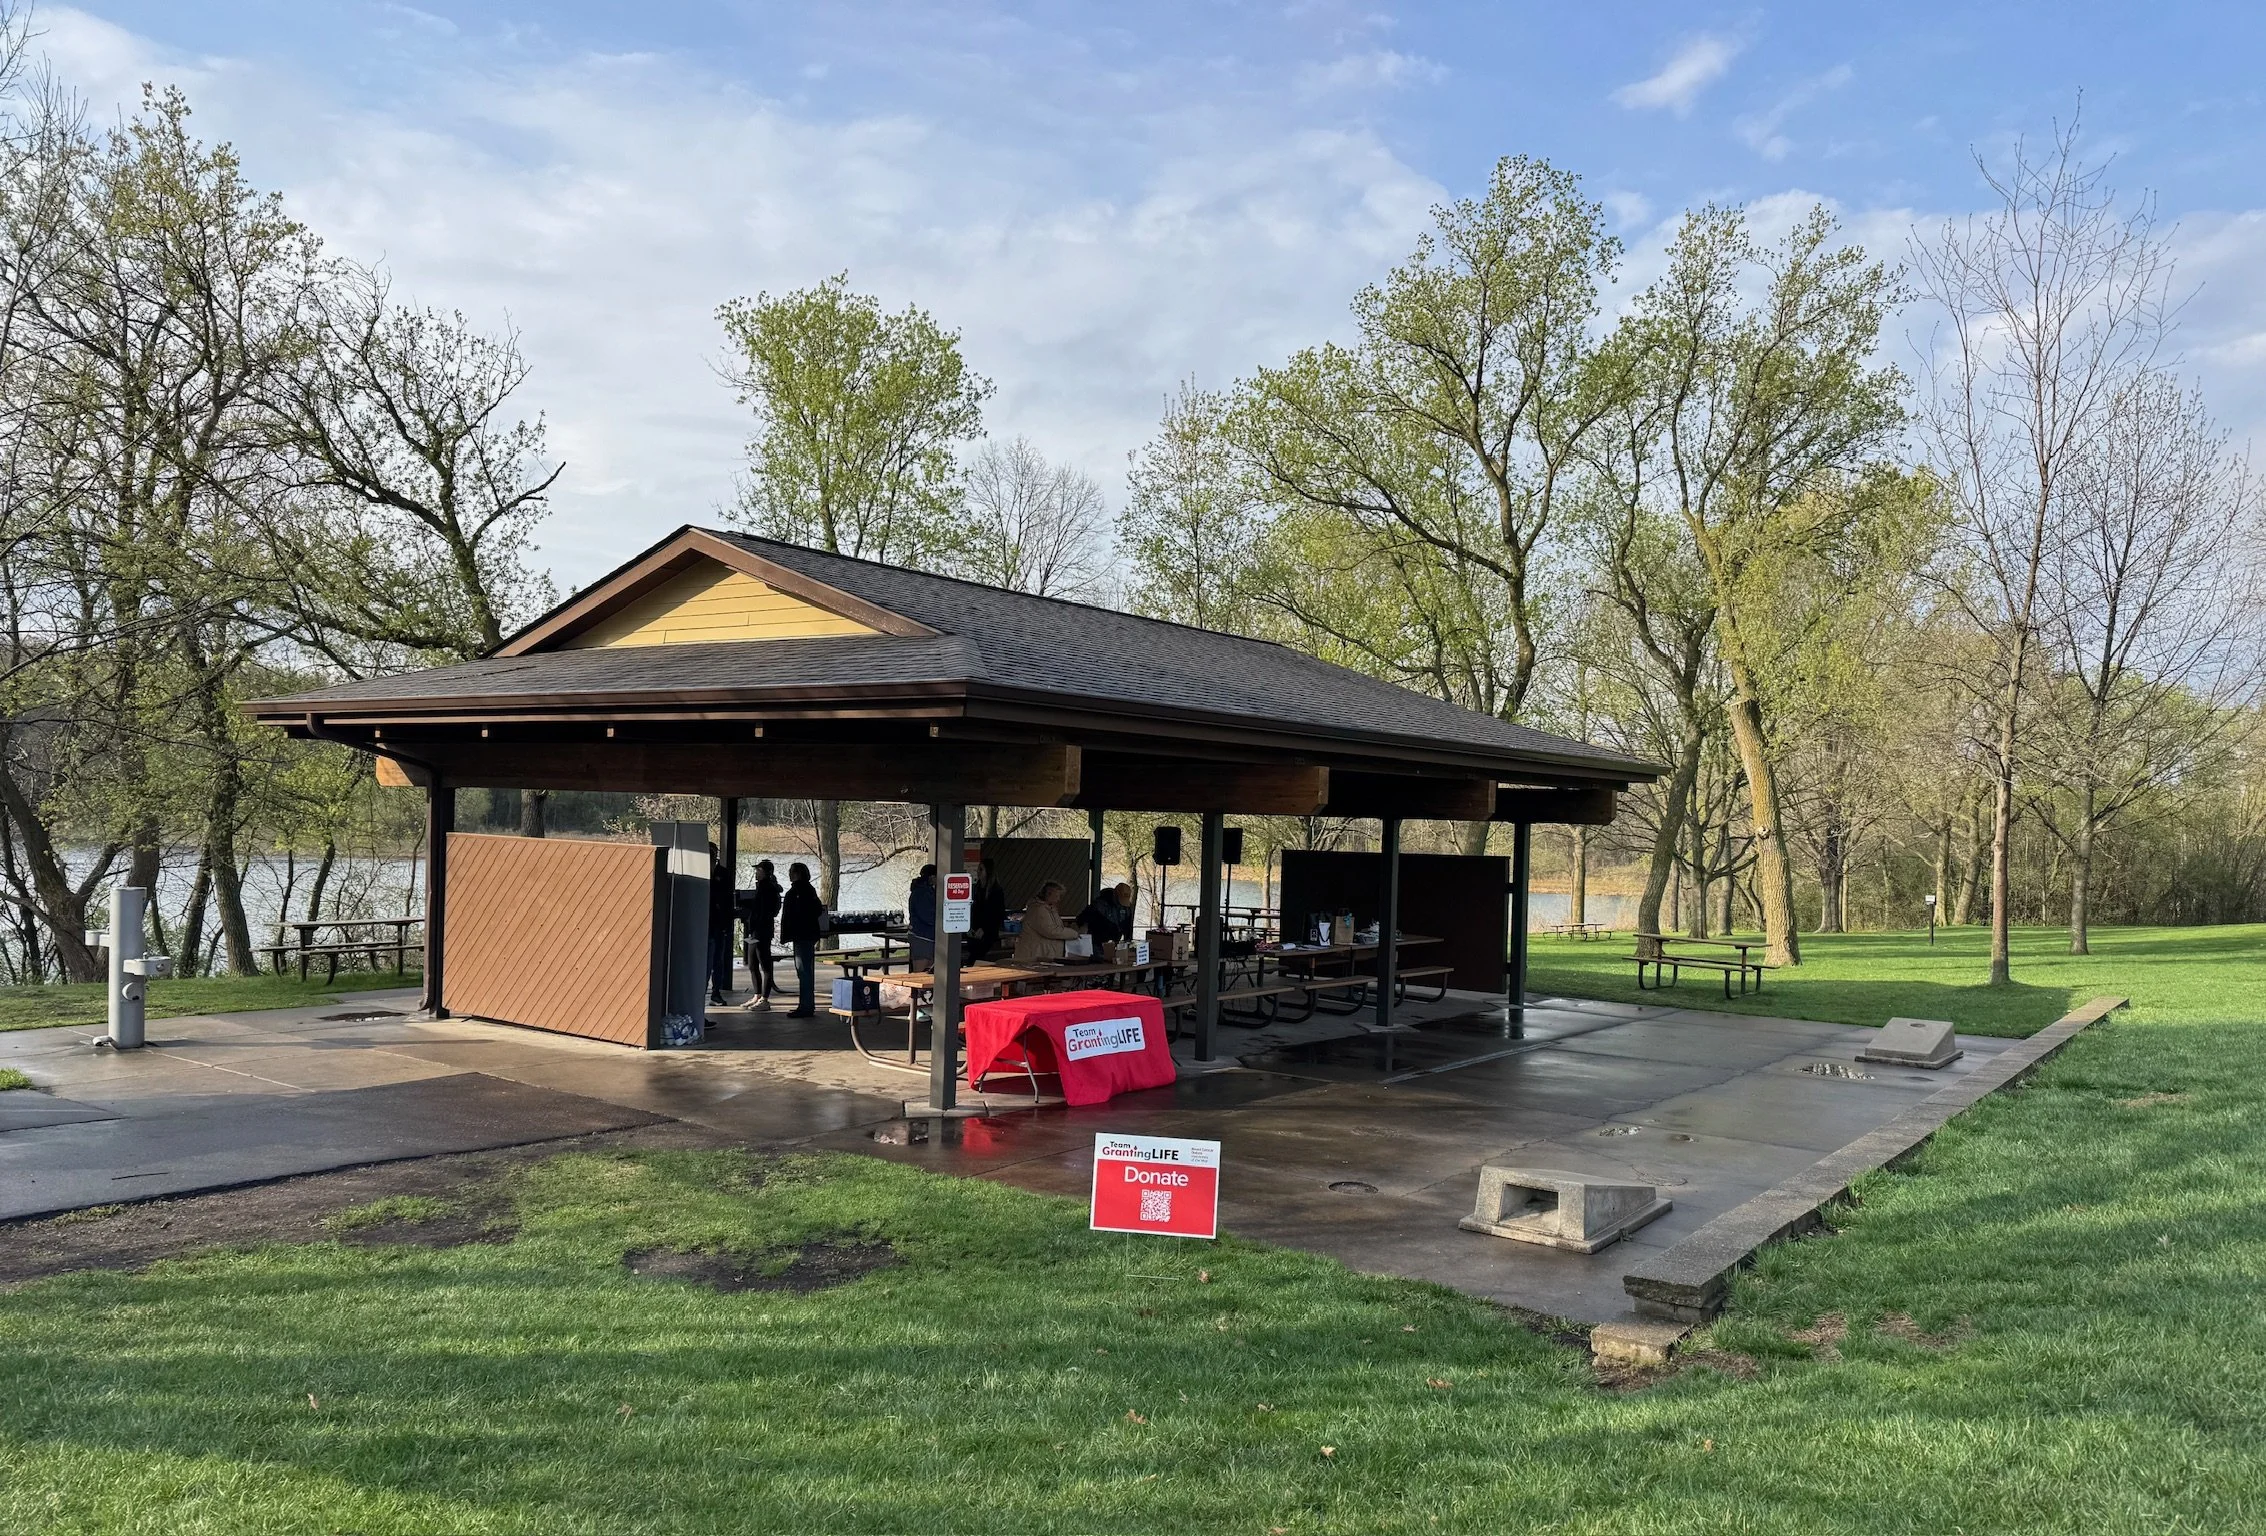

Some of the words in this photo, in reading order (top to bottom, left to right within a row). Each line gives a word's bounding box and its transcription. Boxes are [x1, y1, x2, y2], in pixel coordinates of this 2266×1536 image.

[1073, 1028, 1096, 1038] Team
[1110, 1141, 1131, 1149] Team
[1124, 1165, 1189, 1187] Donate
